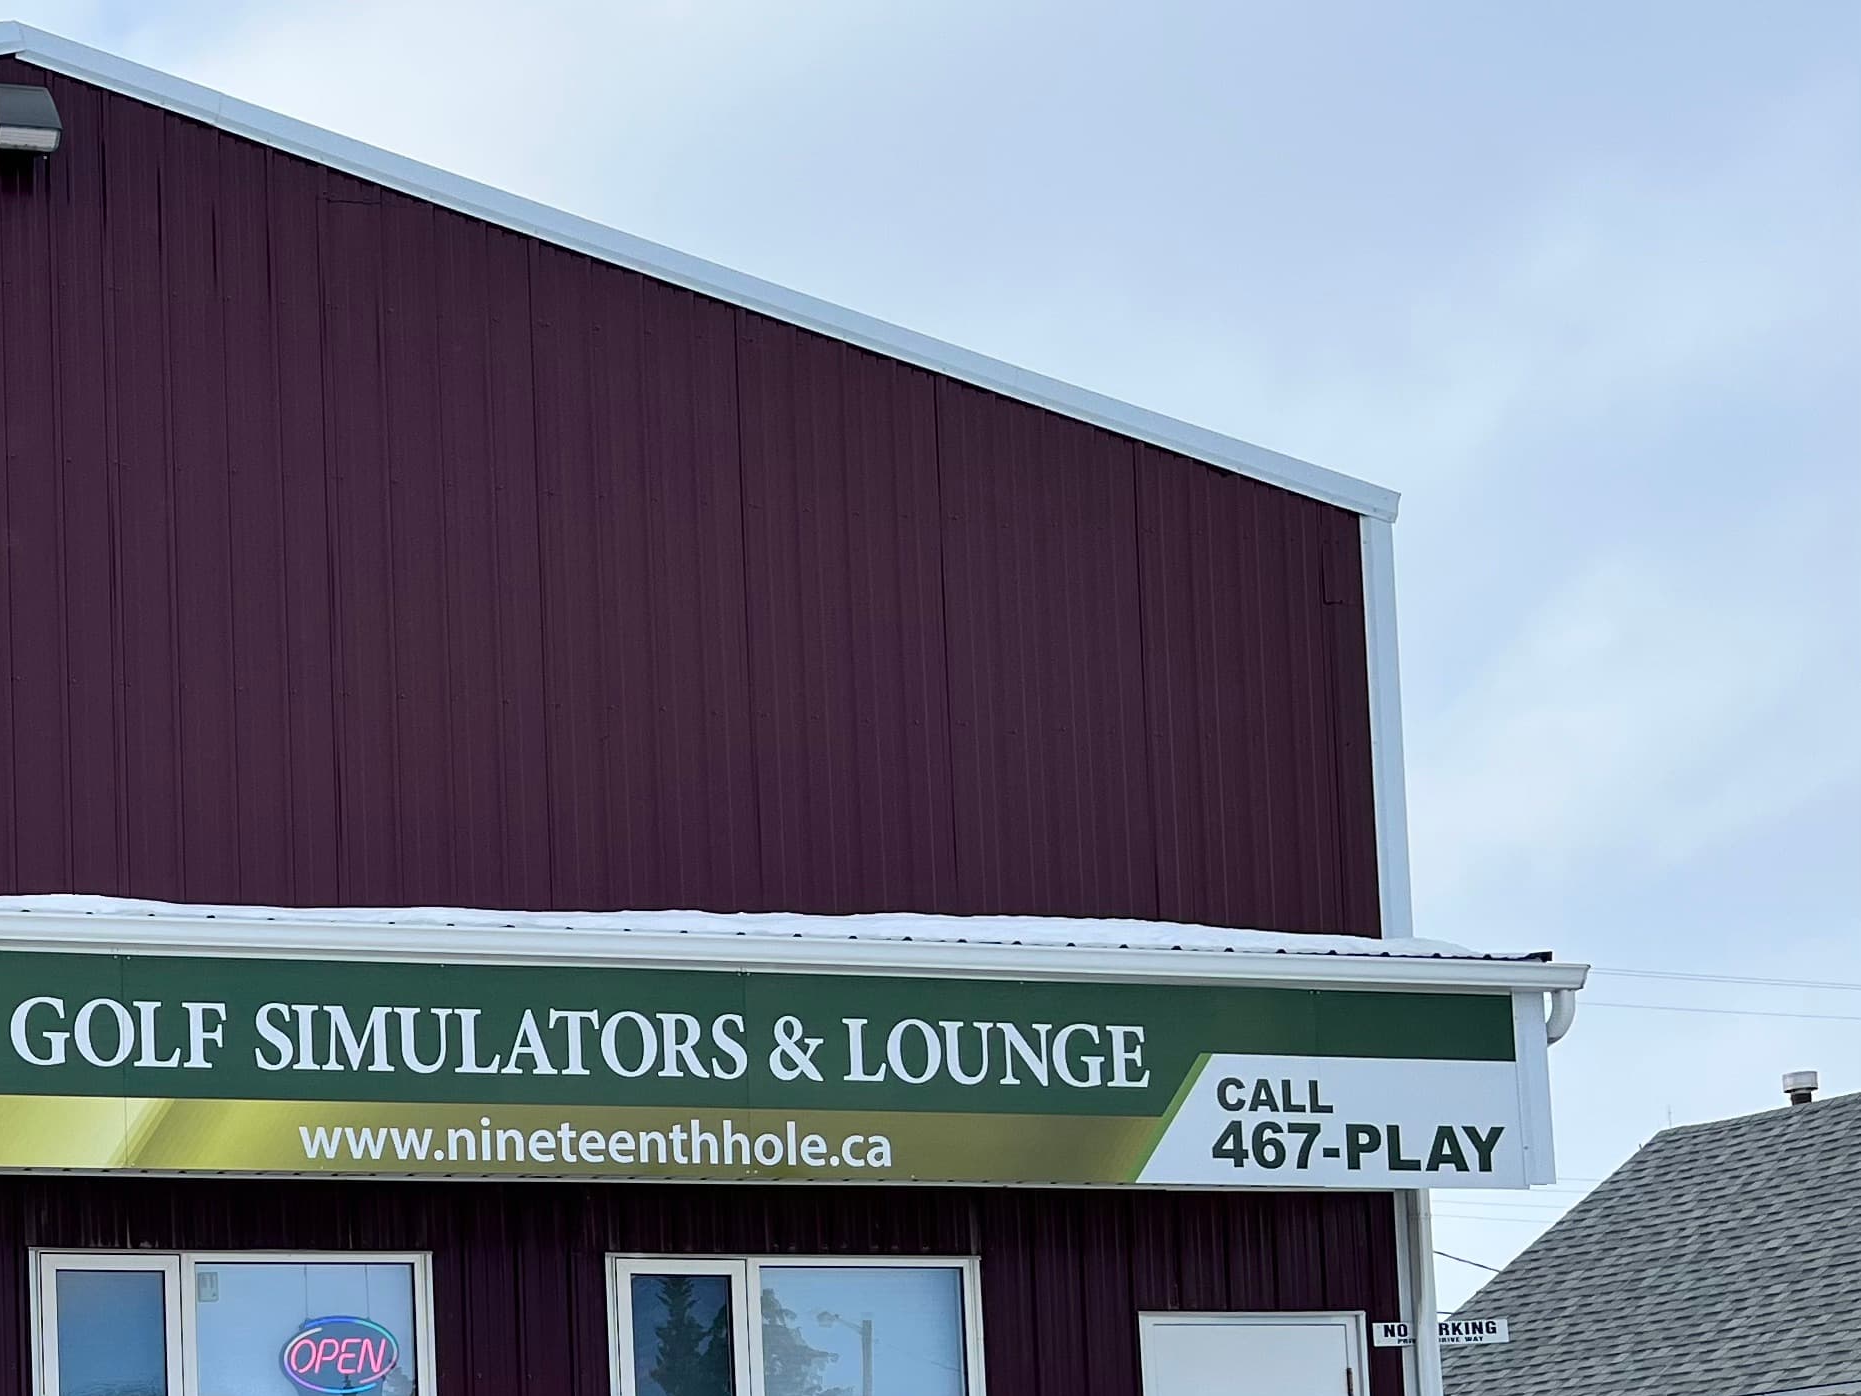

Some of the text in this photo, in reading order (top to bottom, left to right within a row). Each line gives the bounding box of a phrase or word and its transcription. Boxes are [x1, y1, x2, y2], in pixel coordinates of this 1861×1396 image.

[9, 995, 1151, 1090] GOLF SIMULATORS & LOUNGE
[1216, 1076, 1335, 1114] CALL
[298, 1115, 893, 1170] www.nineteenthhole.ca
[1211, 1120, 1506, 1173] 467-PLAY
[1383, 1320, 1497, 1338] NO RKING
[290, 1337, 387, 1375] OPEN
